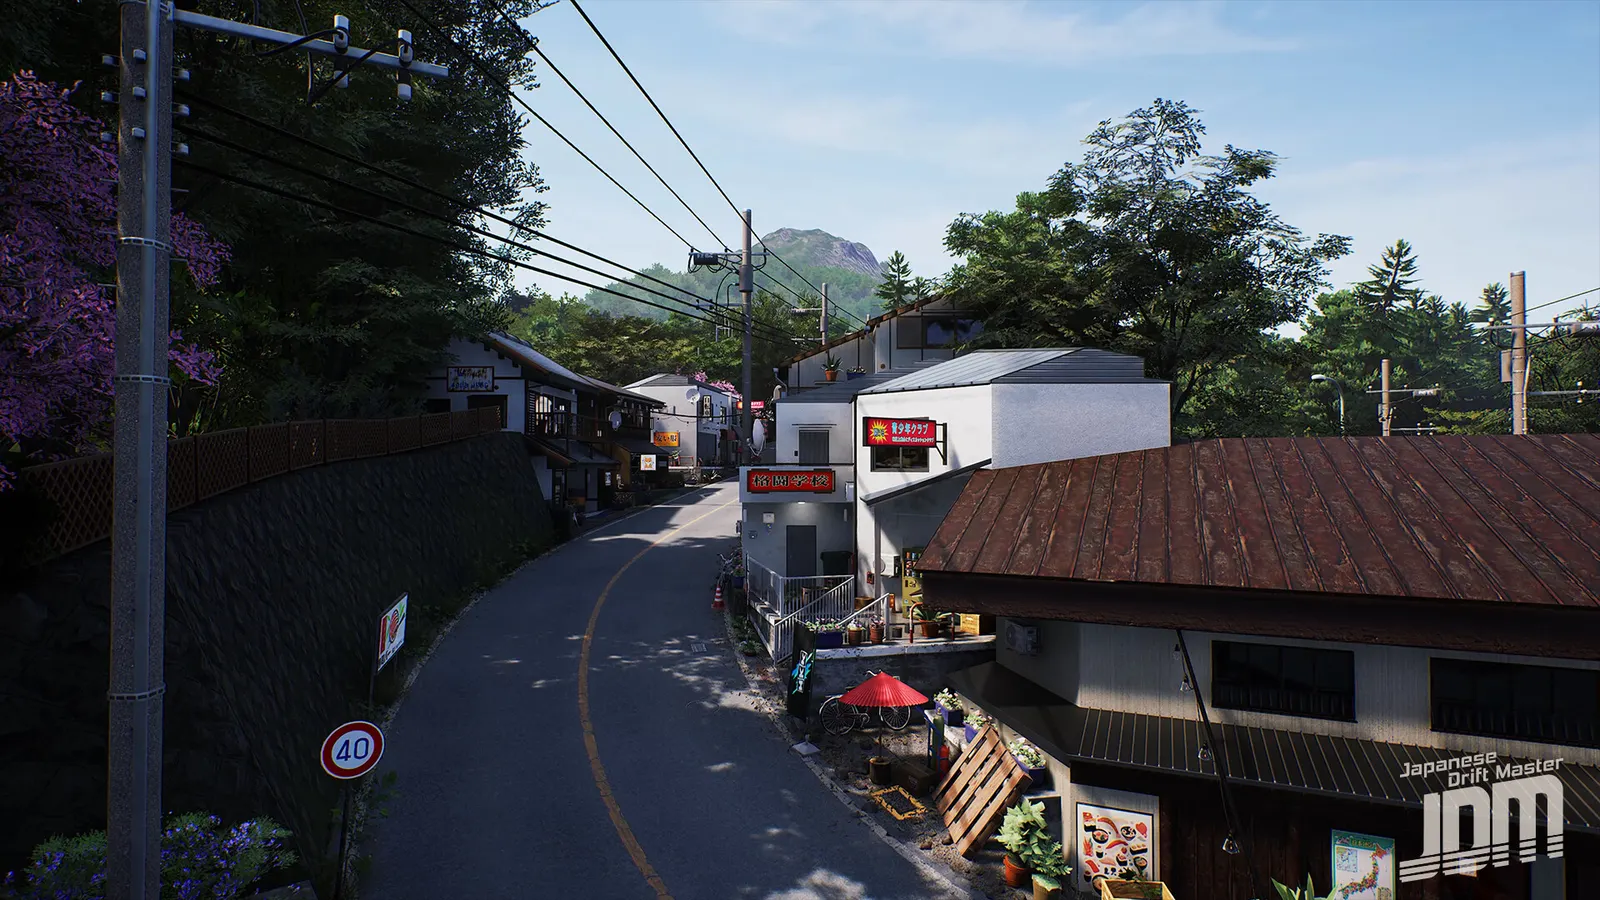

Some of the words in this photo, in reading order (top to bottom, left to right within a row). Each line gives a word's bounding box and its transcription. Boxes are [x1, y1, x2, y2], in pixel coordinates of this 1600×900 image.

[891, 421, 928, 434] 青少年クラブ
[752, 474, 829, 487] 格闘学校
[336, 738, 369, 761] 40
